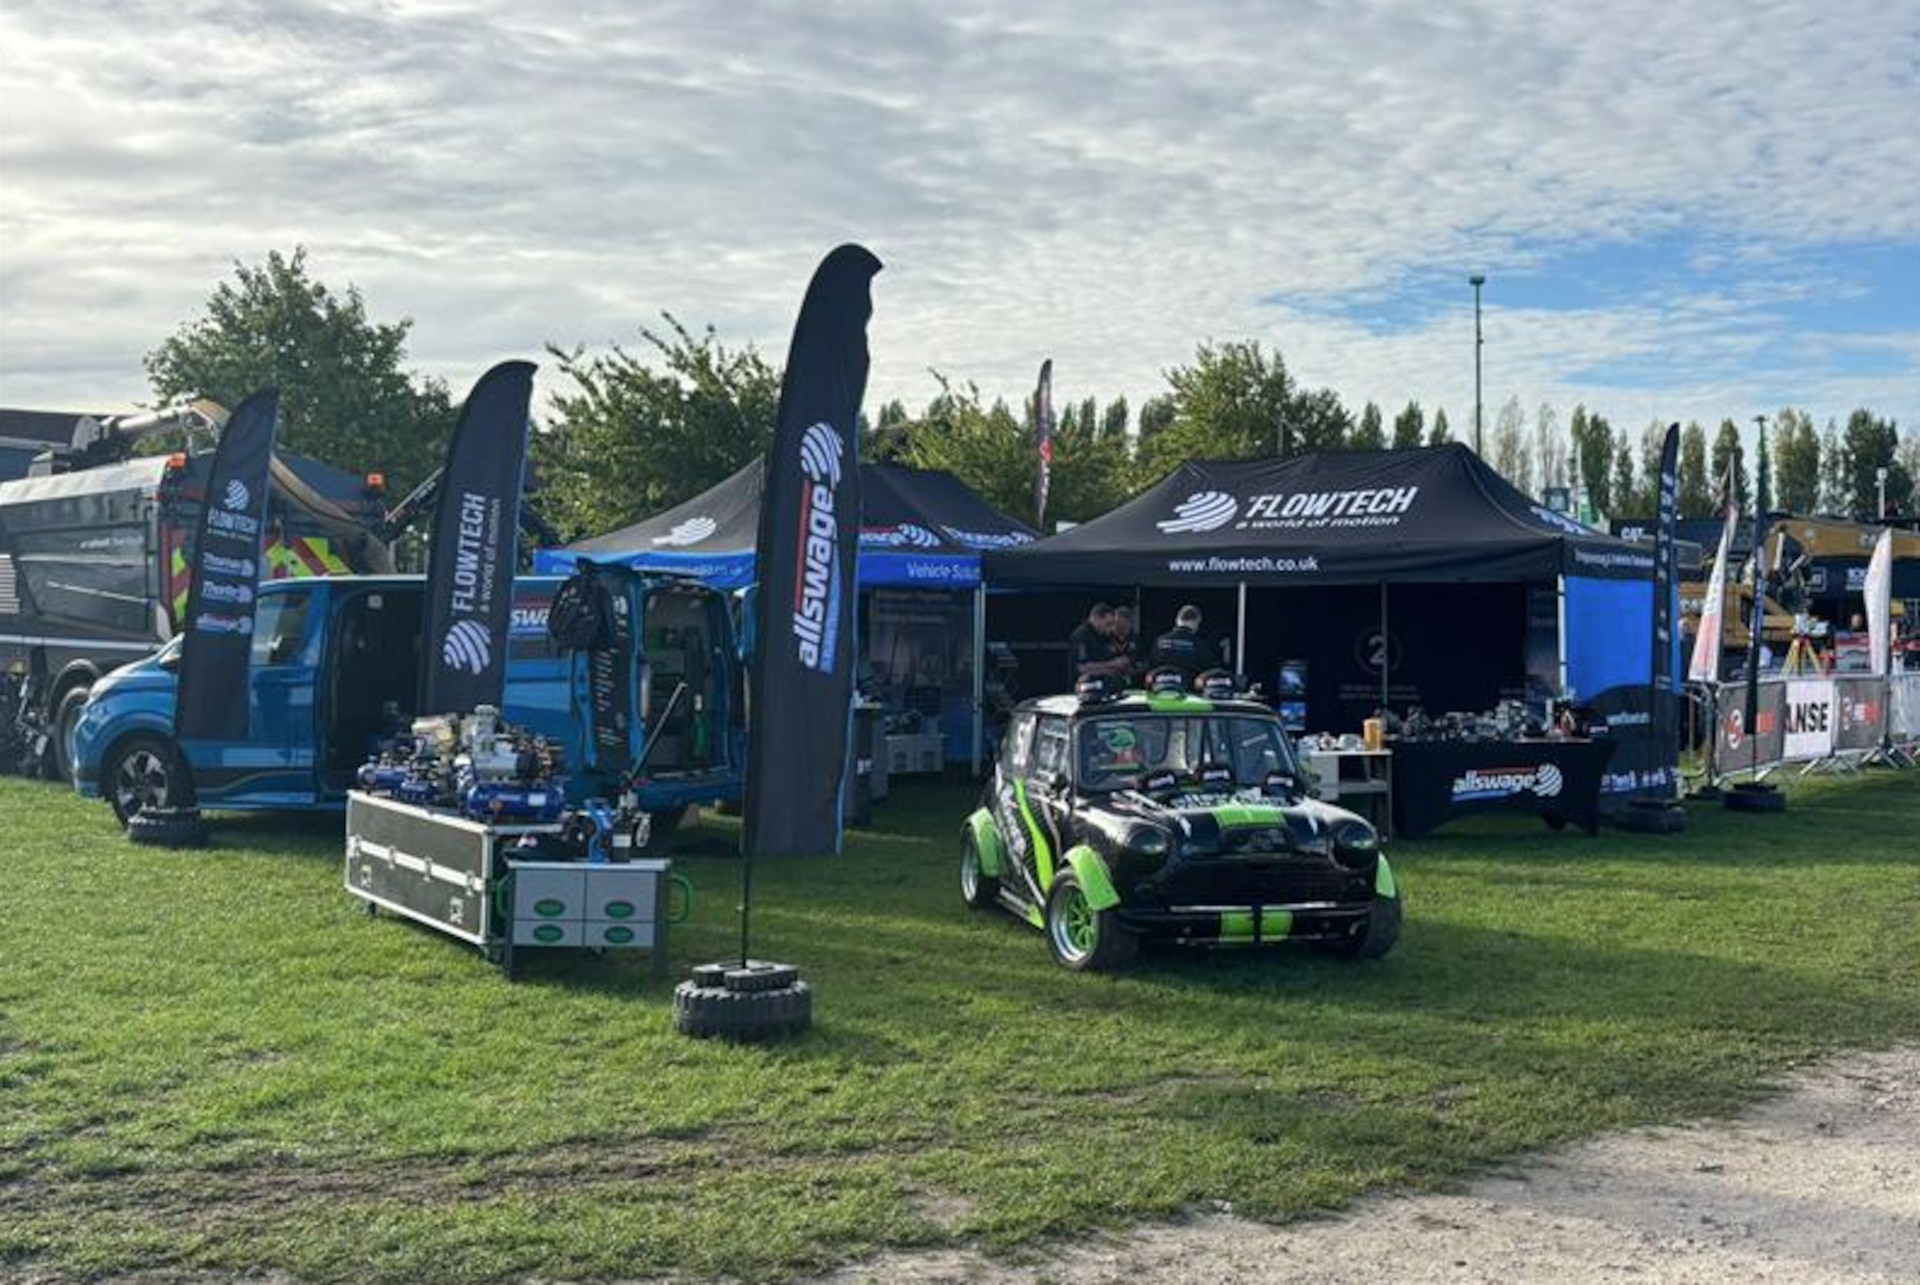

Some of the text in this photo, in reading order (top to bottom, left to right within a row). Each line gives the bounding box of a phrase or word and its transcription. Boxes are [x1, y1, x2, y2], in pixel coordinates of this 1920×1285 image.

[1246, 486, 1418, 518] FLOWTECH
[1235, 515, 1400, 531] a world of motion
[452, 493, 486, 612] FLOWTECH
[1169, 556, 1318, 571] www.flowtech.co.uk
[794, 484, 837, 669] allswage
[906, 561, 951, 579] Vehicle
[1452, 770, 1536, 793] allswage
